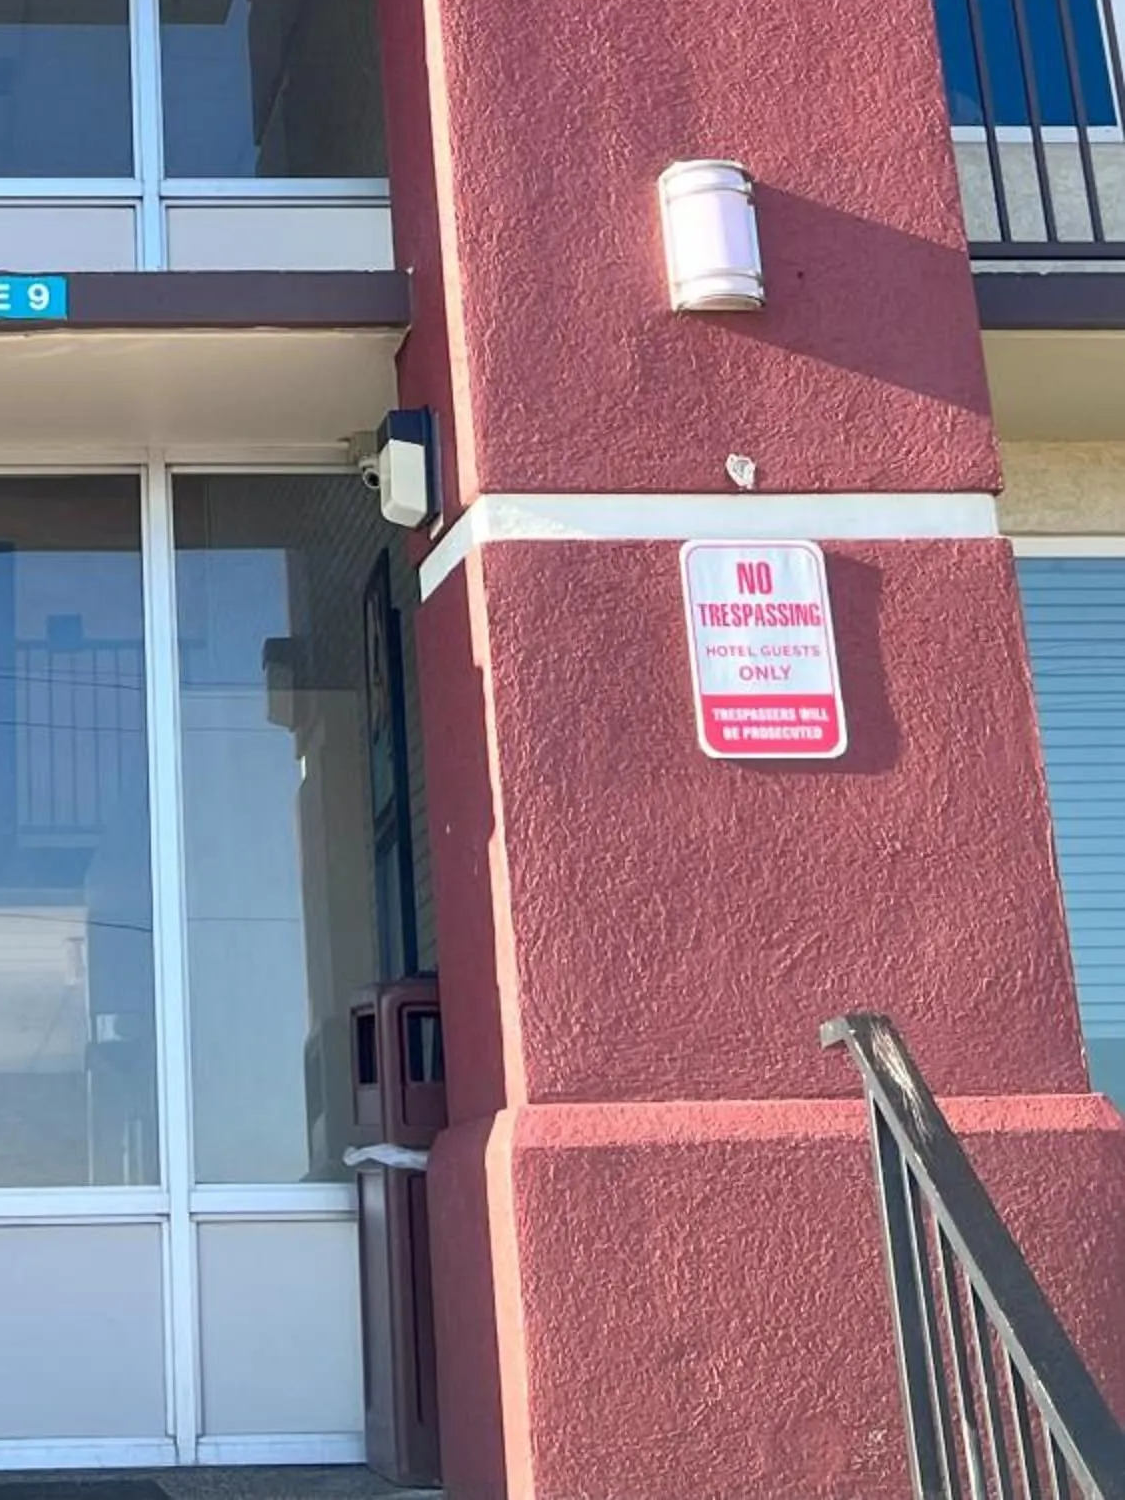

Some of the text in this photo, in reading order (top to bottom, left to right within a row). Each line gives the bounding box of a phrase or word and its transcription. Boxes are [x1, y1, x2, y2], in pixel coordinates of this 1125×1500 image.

[27, 283, 50, 311] 9
[736, 561, 773, 595] NO
[698, 603, 823, 627] TRESPASSING
[706, 645, 820, 657] HOTEL GUESTS
[738, 665, 791, 681] ONLY
